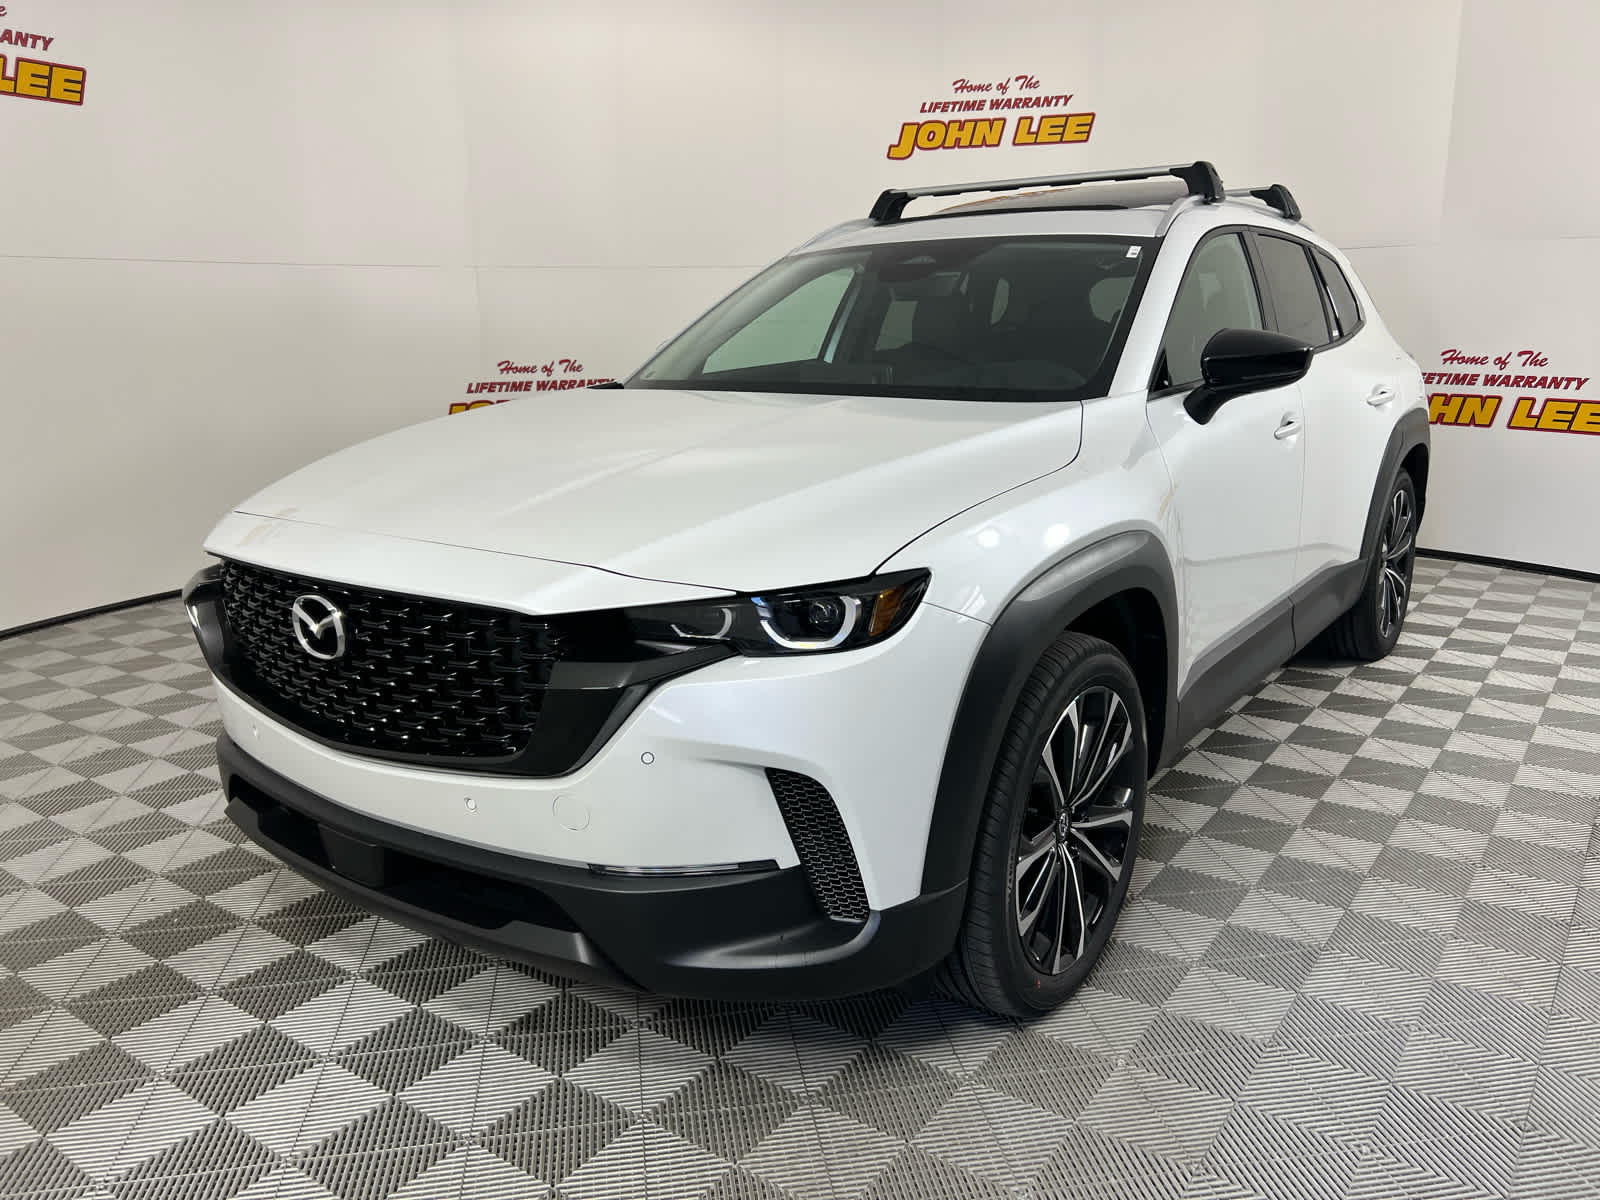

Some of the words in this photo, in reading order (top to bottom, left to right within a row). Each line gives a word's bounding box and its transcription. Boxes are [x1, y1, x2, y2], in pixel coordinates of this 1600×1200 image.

[0, 29, 54, 51] ANTY
[952, 78, 993, 94] Home
[996, 77, 1011, 95] of
[1014, 75, 1040, 90] The
[919, 99, 985, 113] LIFETIME
[989, 94, 1073, 110] WARRANTY
[887, 117, 1006, 160] JOHN
[1012, 112, 1096, 146] LEE
[497, 360, 537, 375] Home
[541, 362, 554, 377] of
[558, 359, 583, 373] The
[1440, 349, 1489, 365] Home
[1493, 352, 1512, 370] of
[1517, 350, 1549, 367] The
[466, 381, 533, 394] LIFETIME
[1421, 372, 1481, 386] ETIME
[1483, 374, 1590, 390] WARRANTY
[1427, 393, 1503, 428] HN
[1507, 397, 1600, 436] LEE
